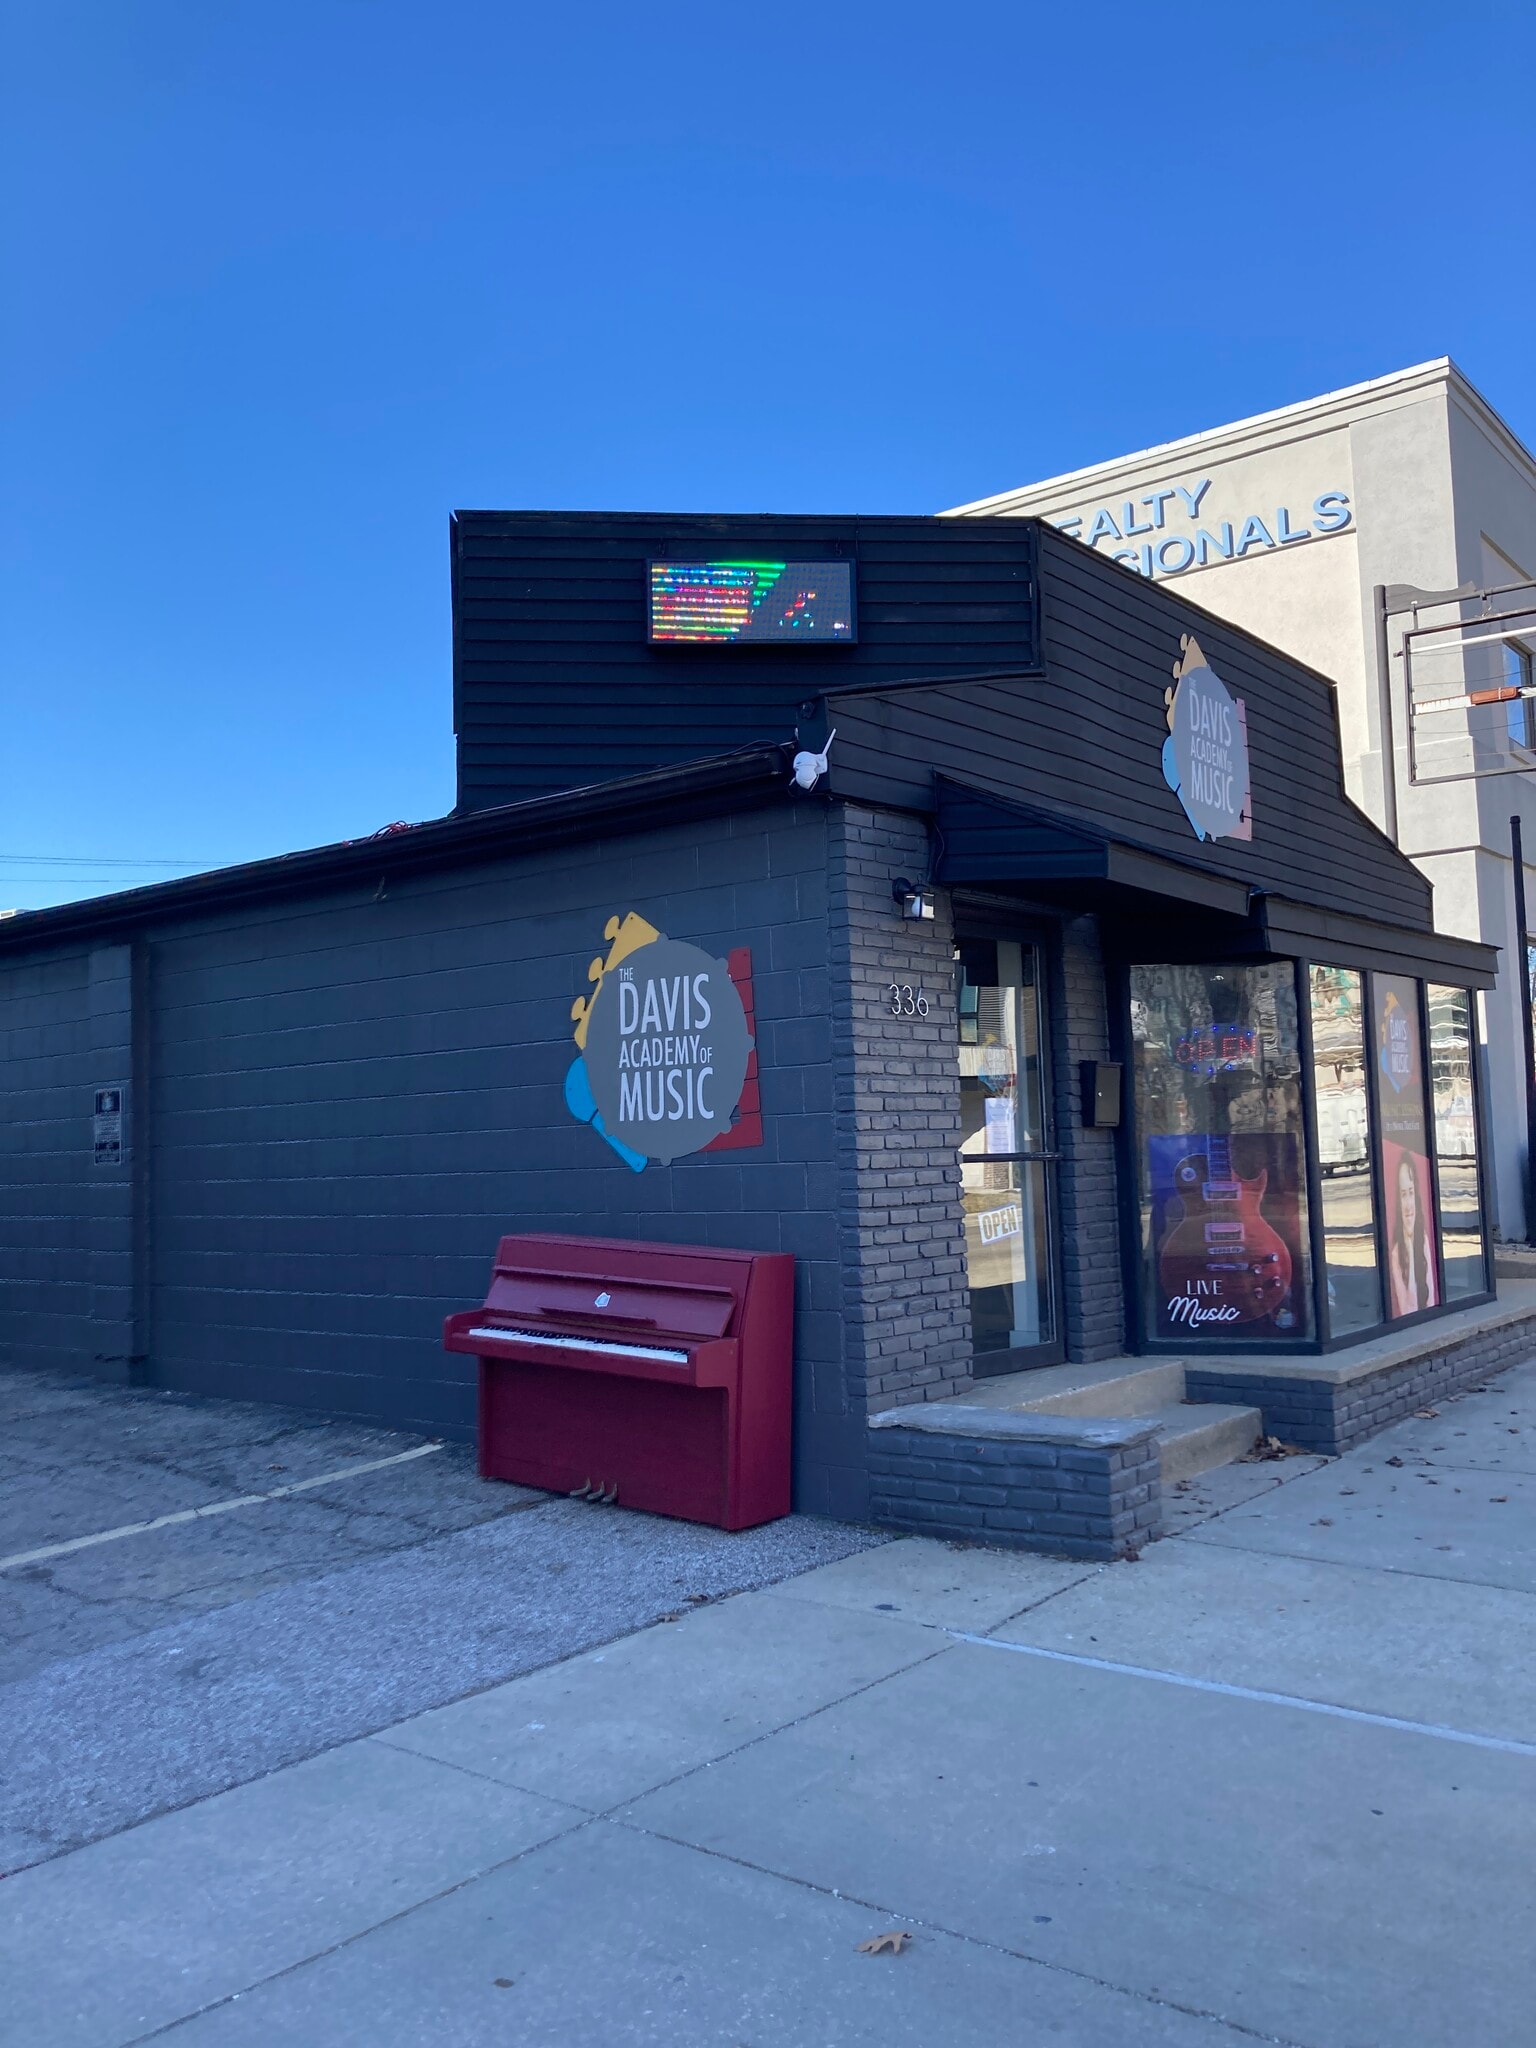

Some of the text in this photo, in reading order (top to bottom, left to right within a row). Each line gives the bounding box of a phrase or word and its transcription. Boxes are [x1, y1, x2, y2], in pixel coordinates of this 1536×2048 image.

[1189, 688, 1232, 747] DAVIS
[1190, 737, 1229, 769] ACADEMY
[1191, 760, 1235, 814] MUSIC
[618, 967, 634, 981] THE
[619, 972, 712, 1035] DAVIS
[889, 984, 929, 1016] 336
[618, 1035, 713, 1068] ACADEMY OF
[1175, 1036, 1257, 1064] OPEN
[619, 1066, 715, 1122] MUSIC
[982, 1206, 1018, 1241] OPEN
[1186, 1279, 1225, 1296] LIVE
[1167, 1295, 1241, 1329] Music
